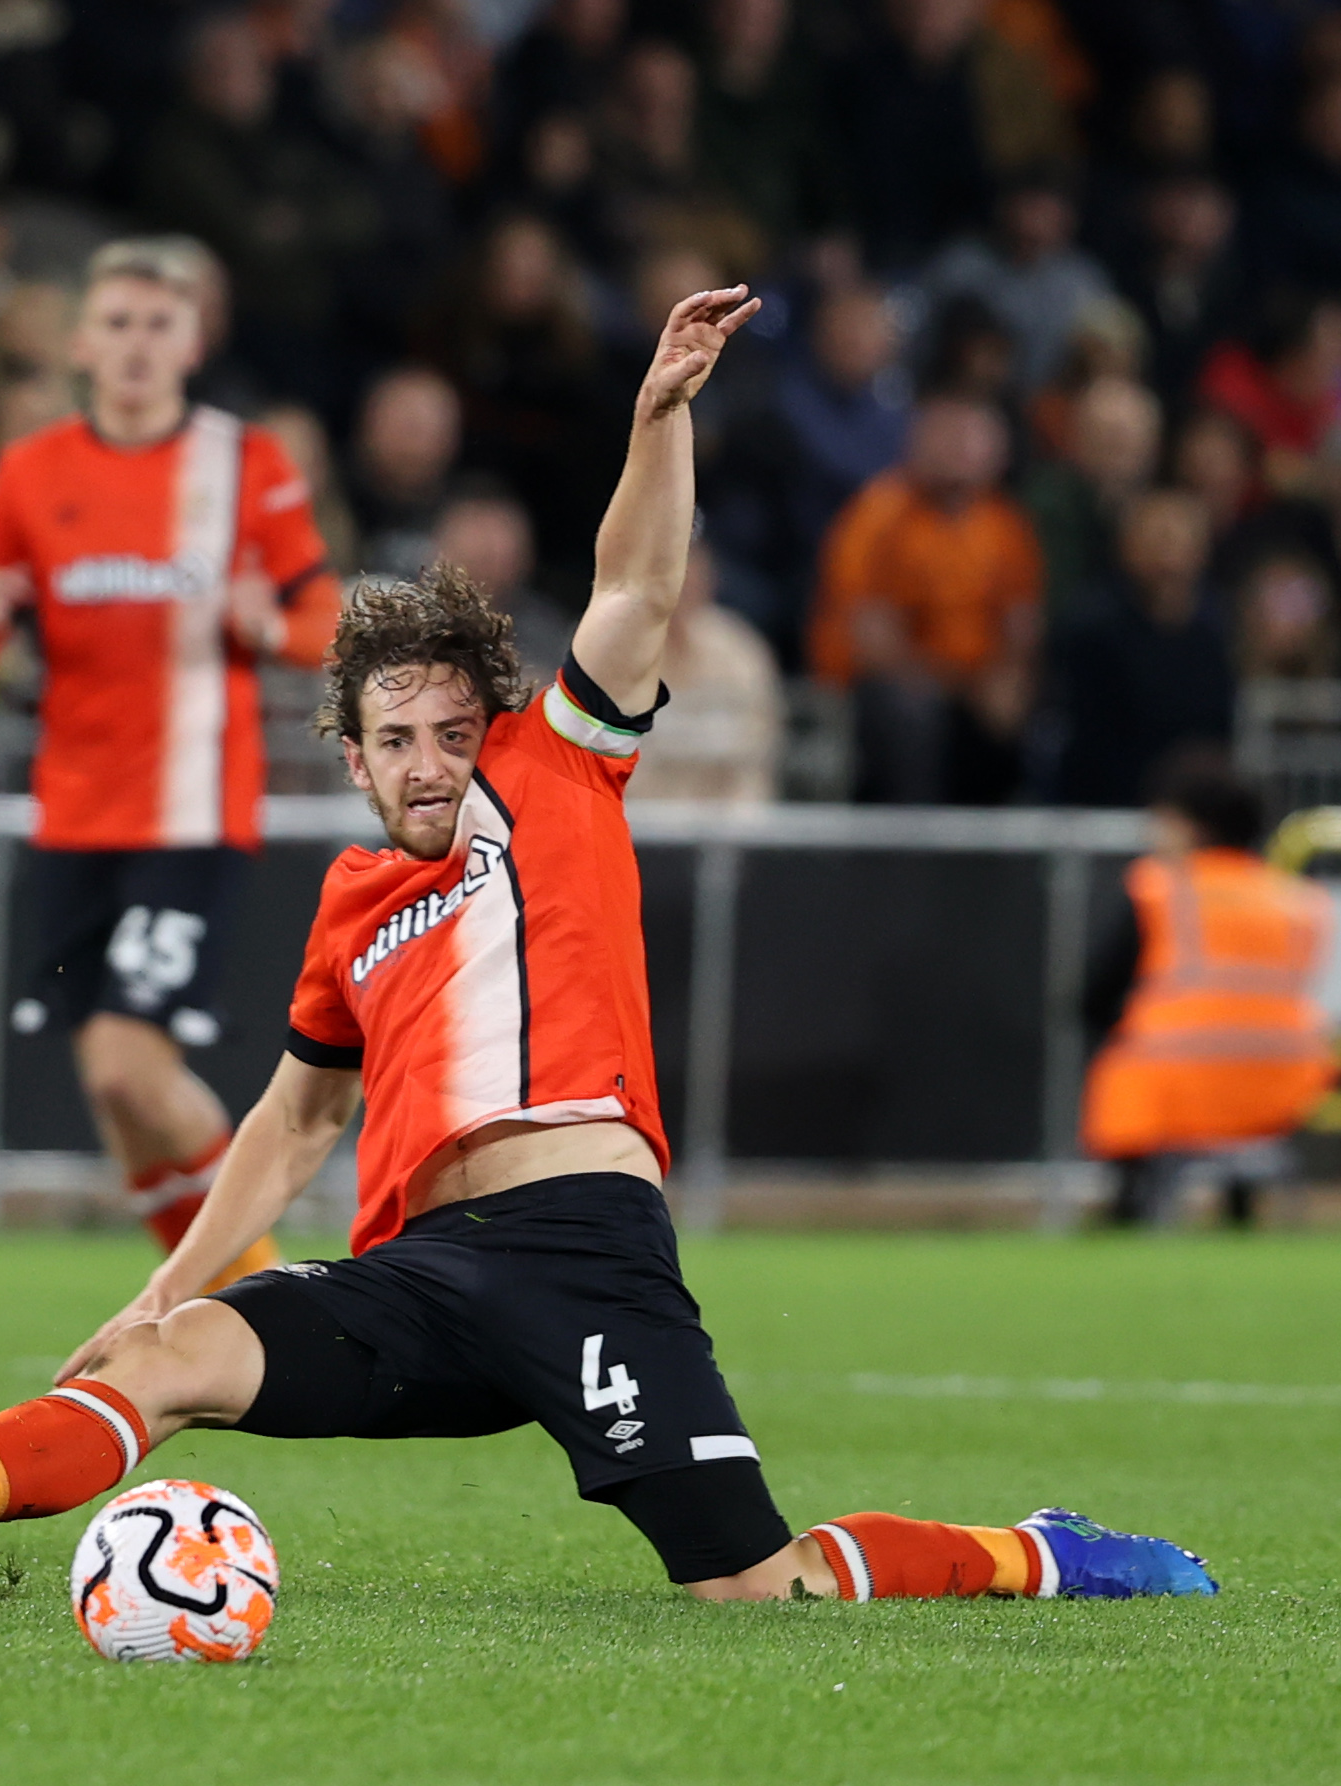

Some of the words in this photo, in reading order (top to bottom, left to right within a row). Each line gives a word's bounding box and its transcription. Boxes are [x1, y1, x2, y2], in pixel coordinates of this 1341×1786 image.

[109, 906, 207, 988] 45
[352, 881, 464, 983] utilita
[581, 1333, 640, 1416] 4
